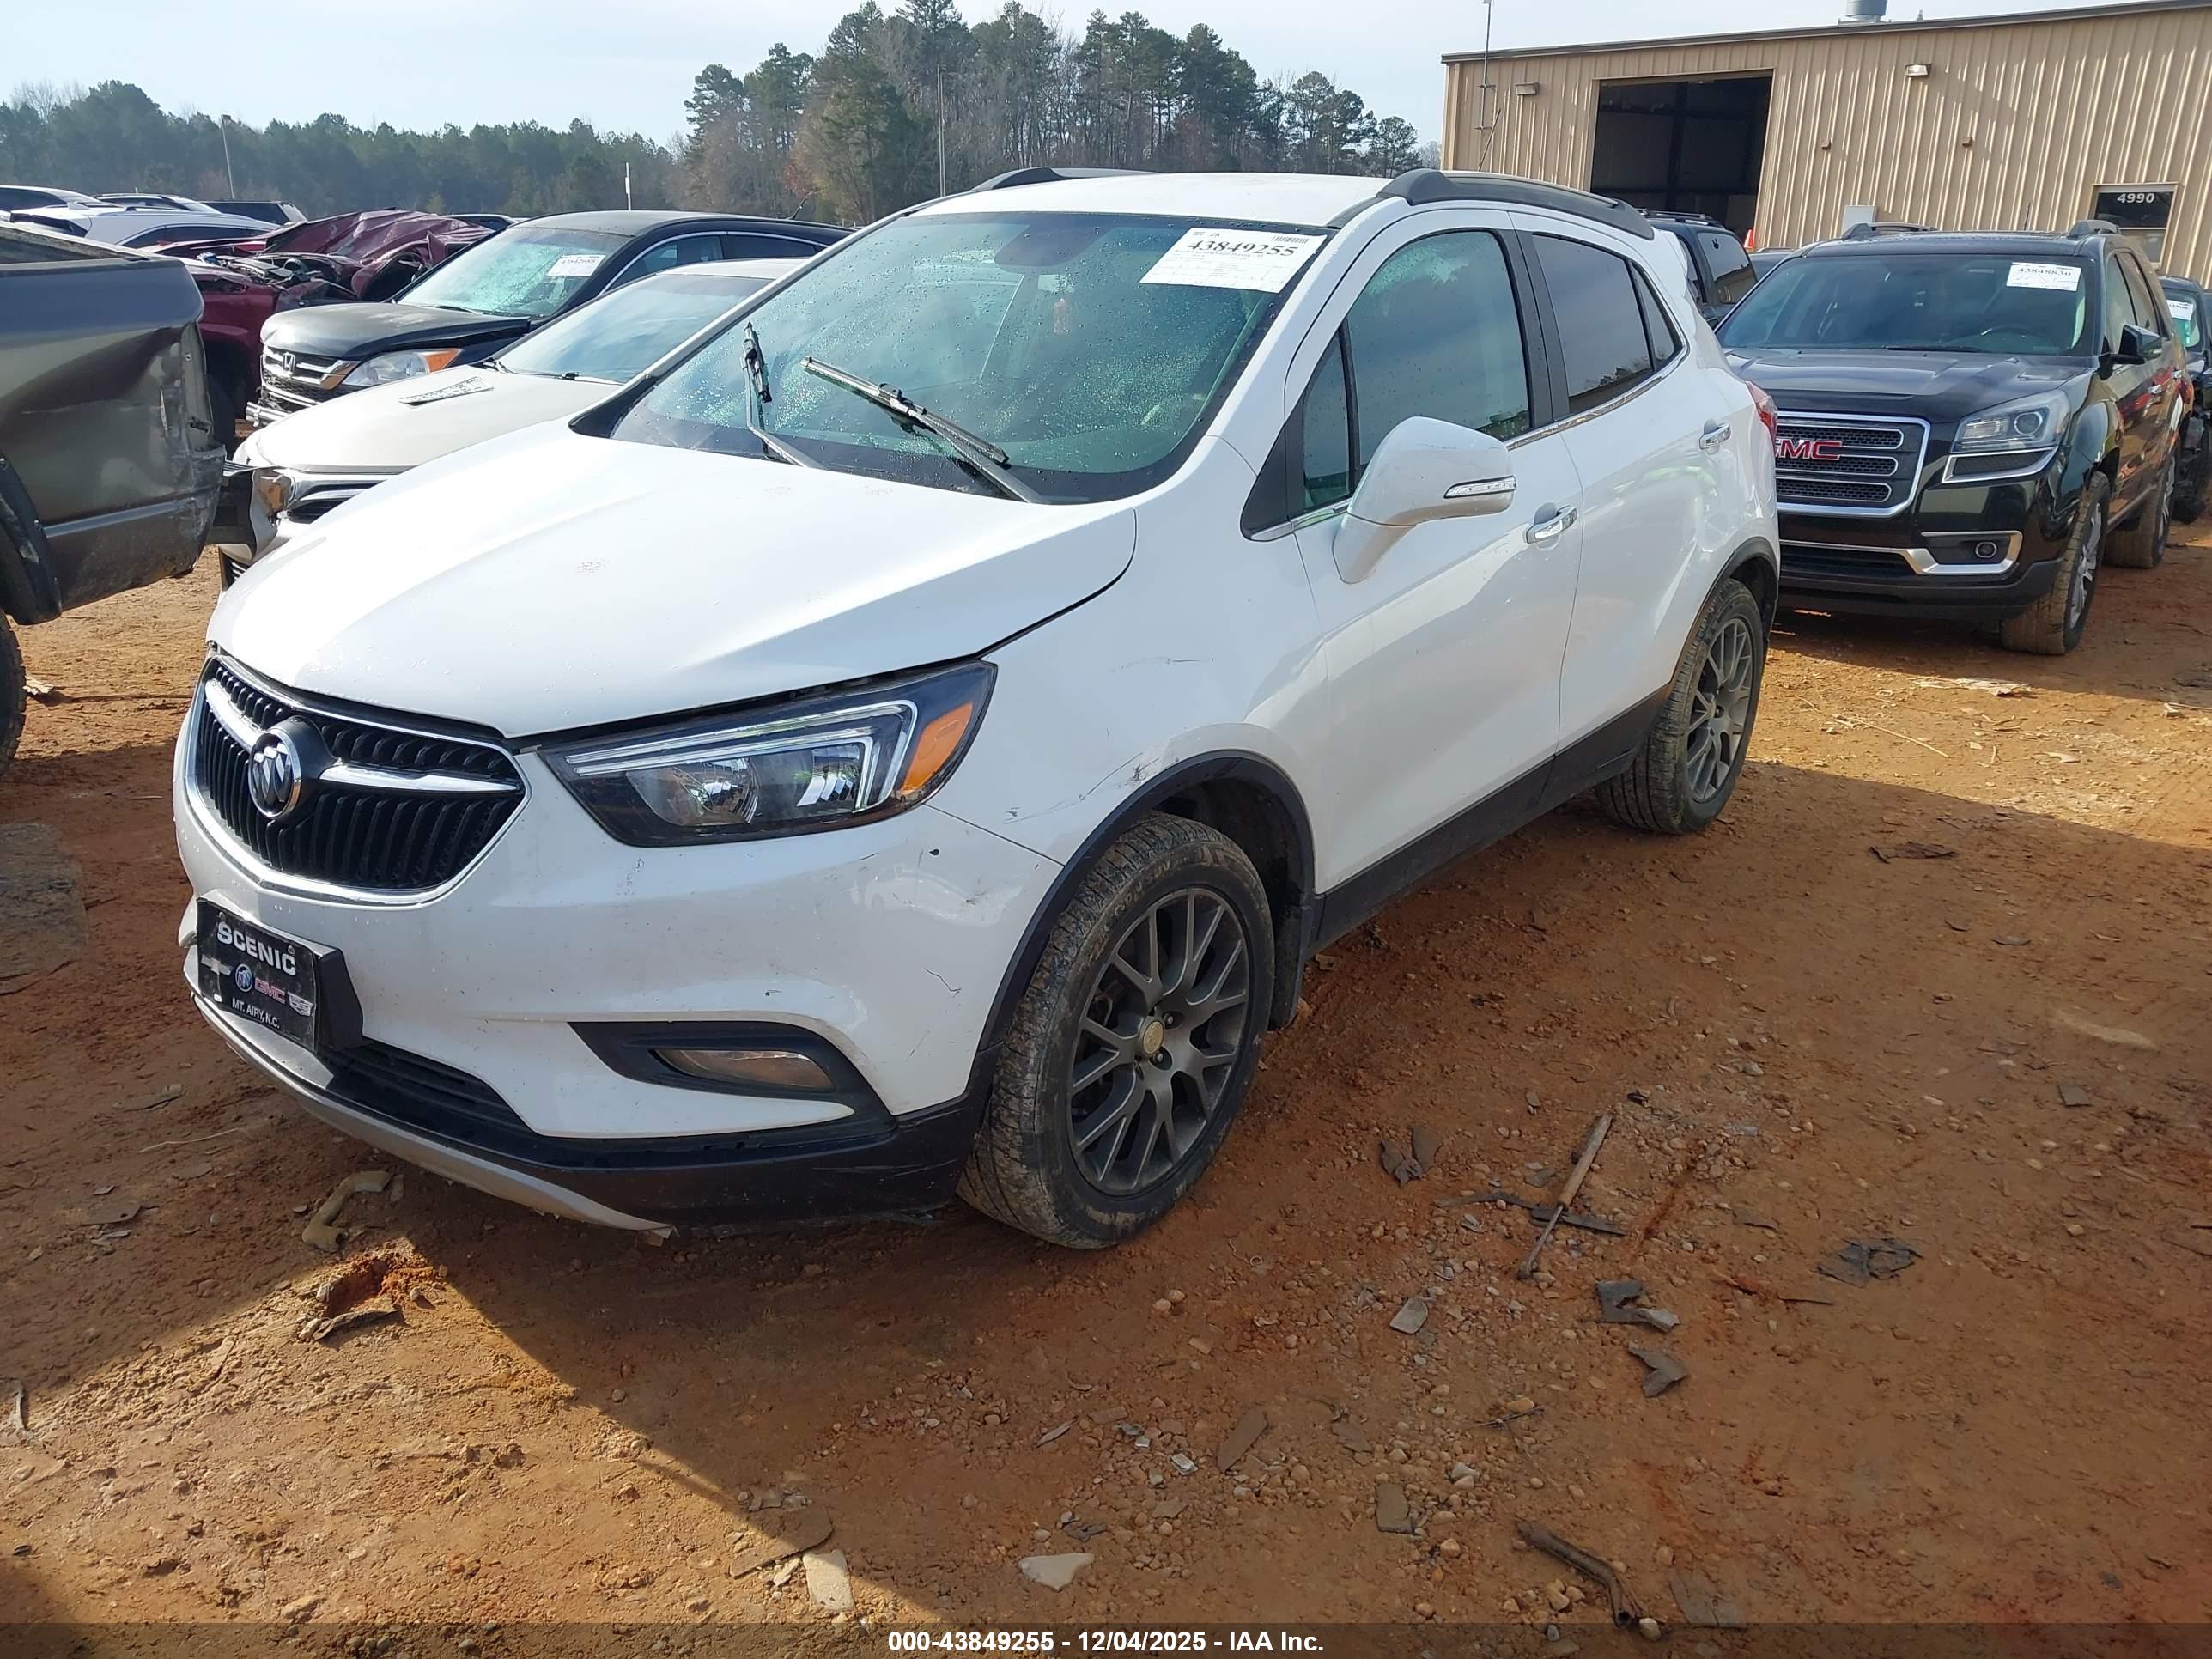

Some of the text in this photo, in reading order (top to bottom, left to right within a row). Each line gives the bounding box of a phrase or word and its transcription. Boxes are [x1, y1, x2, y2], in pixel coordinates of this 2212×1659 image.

[2117, 193, 2155, 204] 4990
[1188, 240, 1299, 257] 43849255
[217, 921, 296, 975] SCENIC
[254, 977, 286, 1003] GMC
